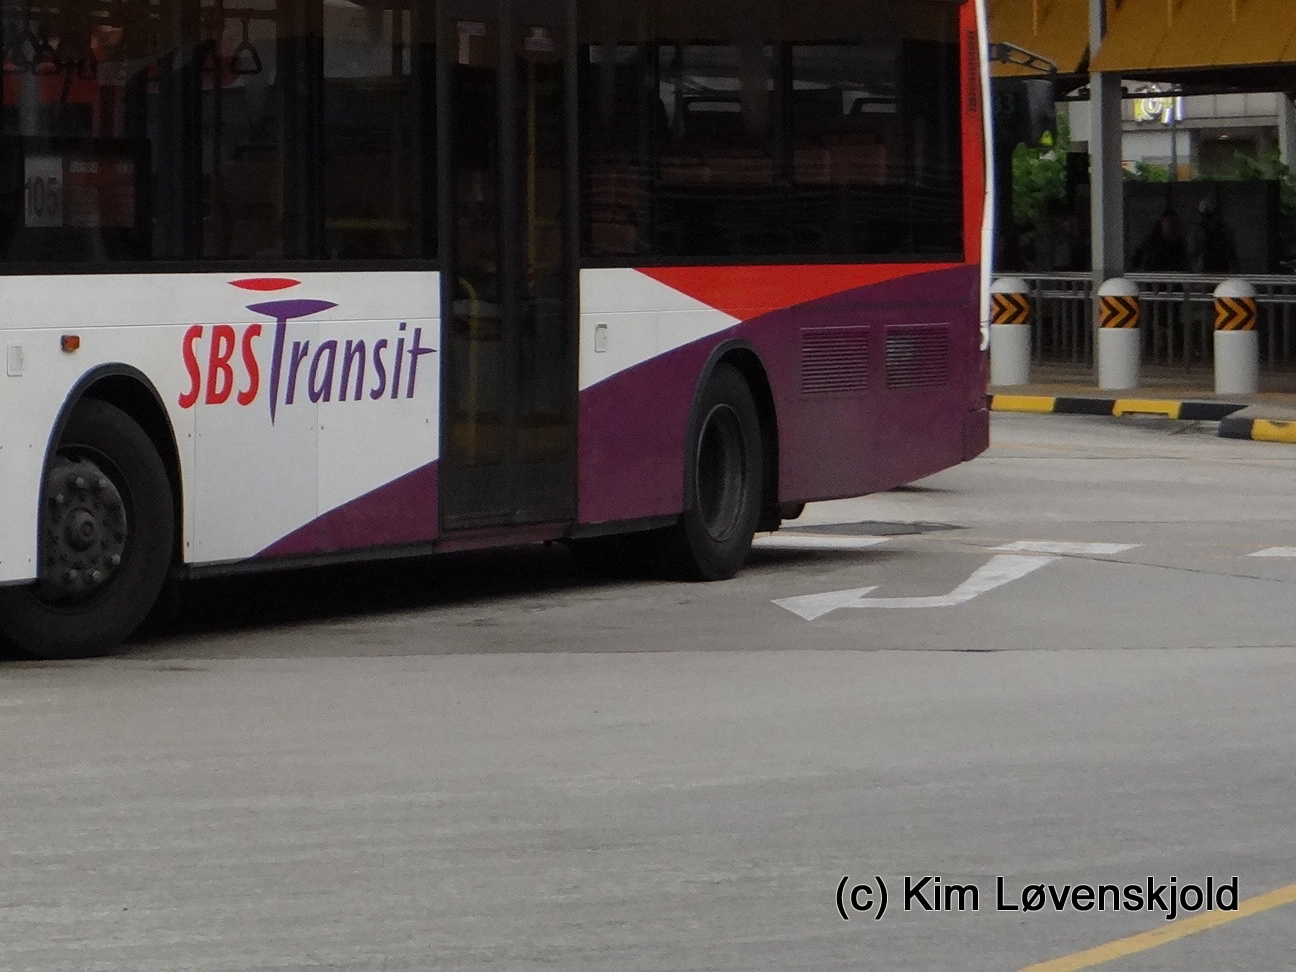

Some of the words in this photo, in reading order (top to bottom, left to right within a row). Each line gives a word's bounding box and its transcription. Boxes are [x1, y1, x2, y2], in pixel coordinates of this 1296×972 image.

[24, 177, 58, 217] 105
[177, 324, 262, 409] SBS
[245, 298, 438, 427] Transit
